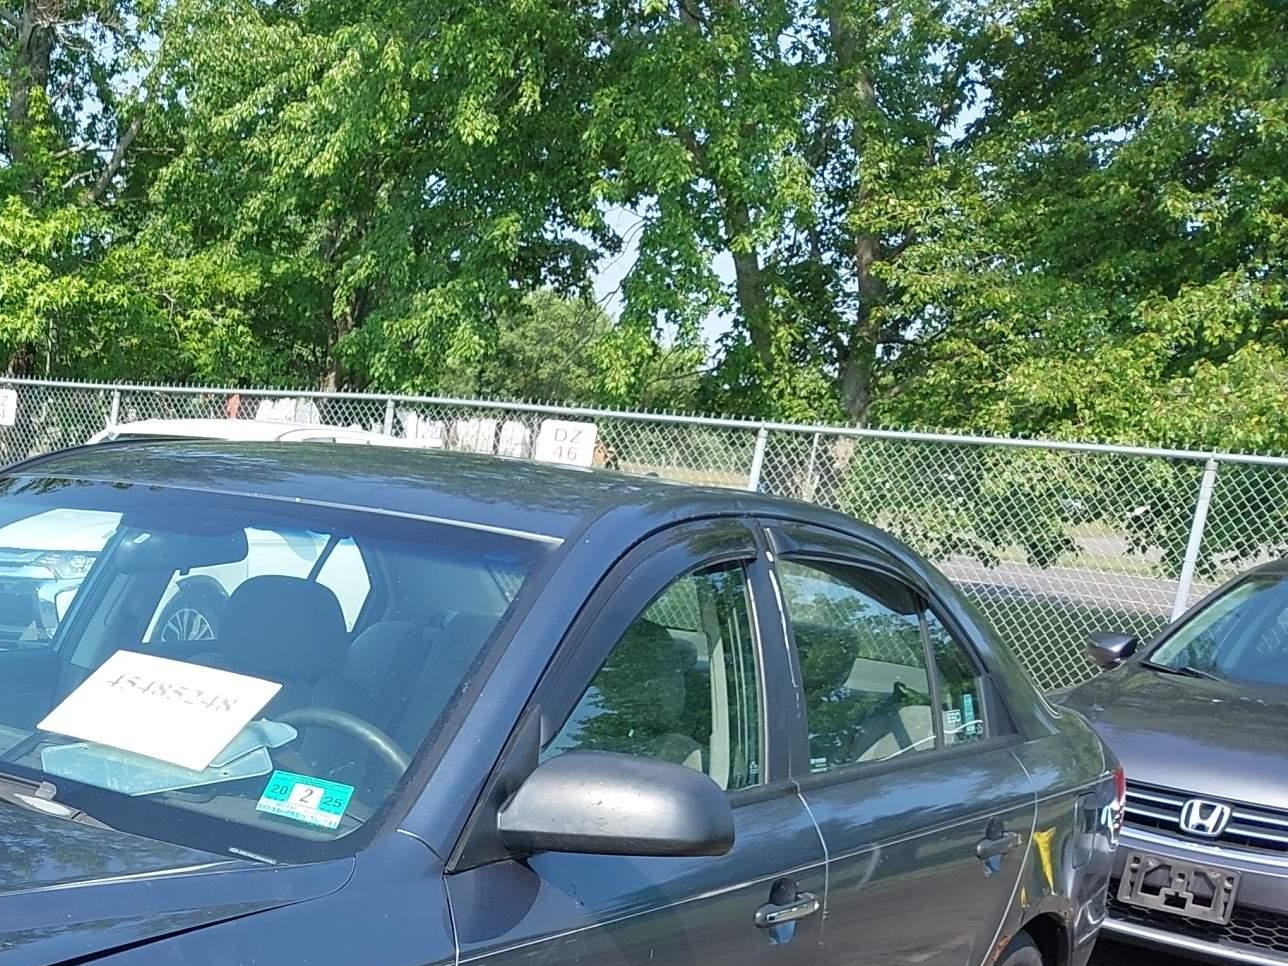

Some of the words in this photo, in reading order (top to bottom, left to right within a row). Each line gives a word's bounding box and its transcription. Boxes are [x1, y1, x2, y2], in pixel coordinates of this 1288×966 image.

[554, 428, 583, 444] DZ
[553, 446, 577, 461] 46
[269, 783, 289, 796] 20
[299, 788, 314, 803] 2
[323, 796, 342, 808] 25
